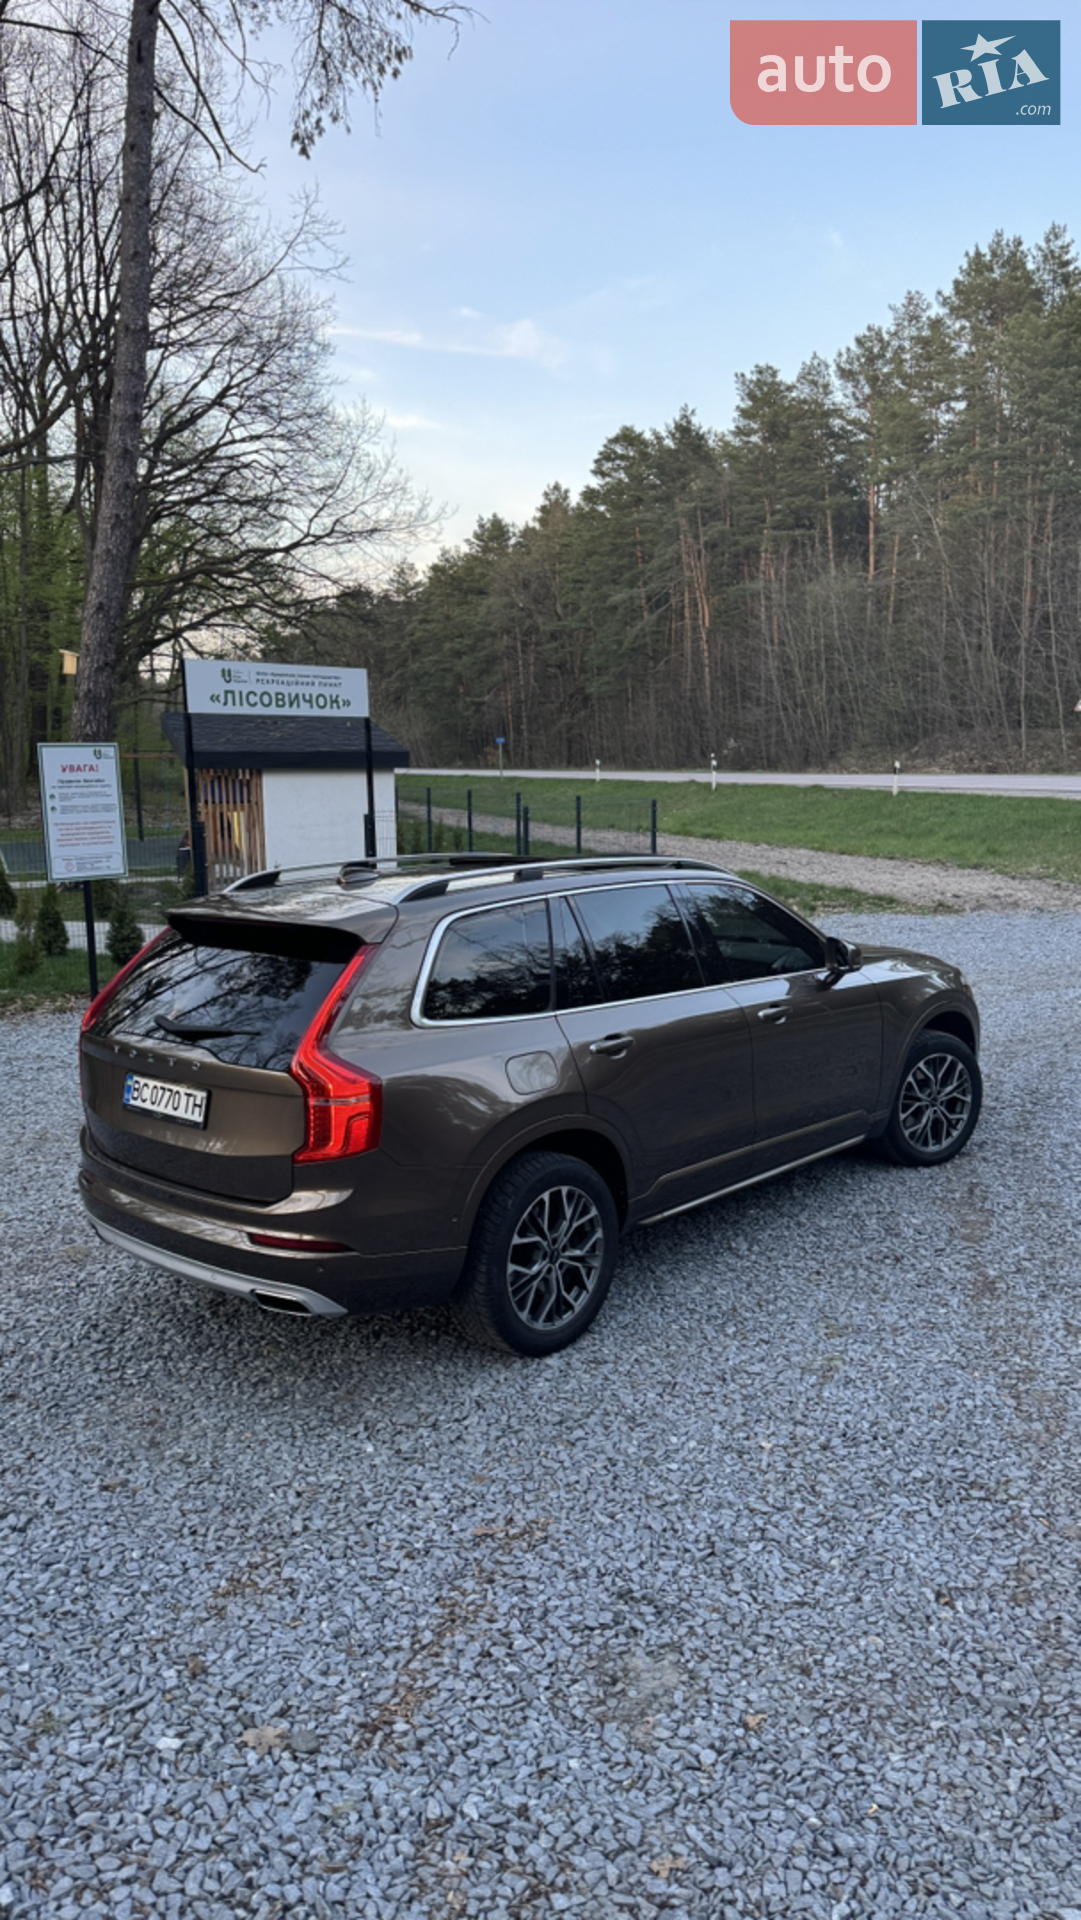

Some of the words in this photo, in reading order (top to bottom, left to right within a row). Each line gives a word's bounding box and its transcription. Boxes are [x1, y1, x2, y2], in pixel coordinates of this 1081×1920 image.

[255, 678, 316, 688] РЕКРЕАЦІЙНИЙ
[209, 689, 352, 710] «ЛІСОВИЧОК»
[60, 763, 100, 773] УВАГА!
